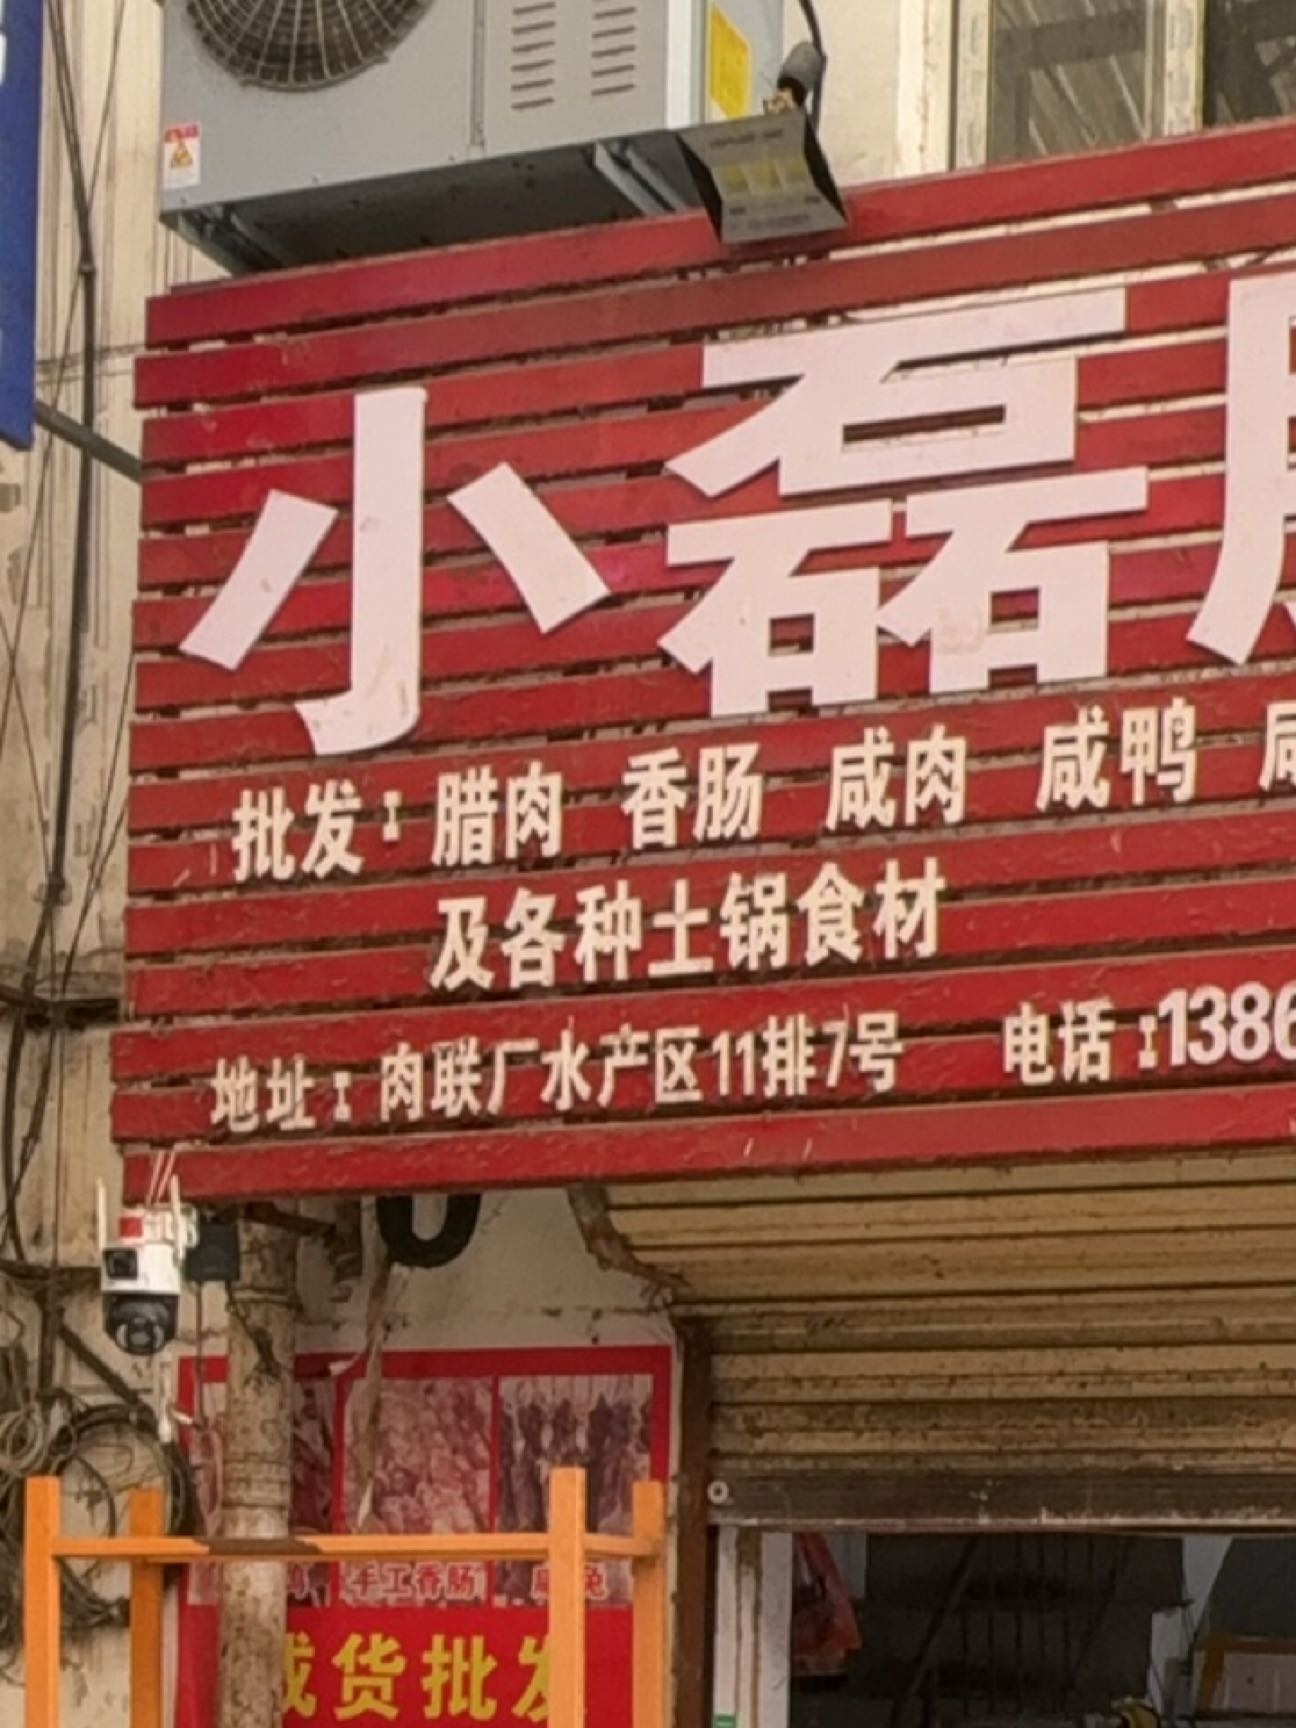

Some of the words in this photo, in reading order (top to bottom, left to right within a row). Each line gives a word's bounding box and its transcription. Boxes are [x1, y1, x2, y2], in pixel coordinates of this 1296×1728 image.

[622, 741, 763, 850] 香肠
[826, 726, 967, 831] 咸肉
[1037, 697, 1198, 812] 咸鸭
[430, 857, 946, 994] 及各种土锅食材
